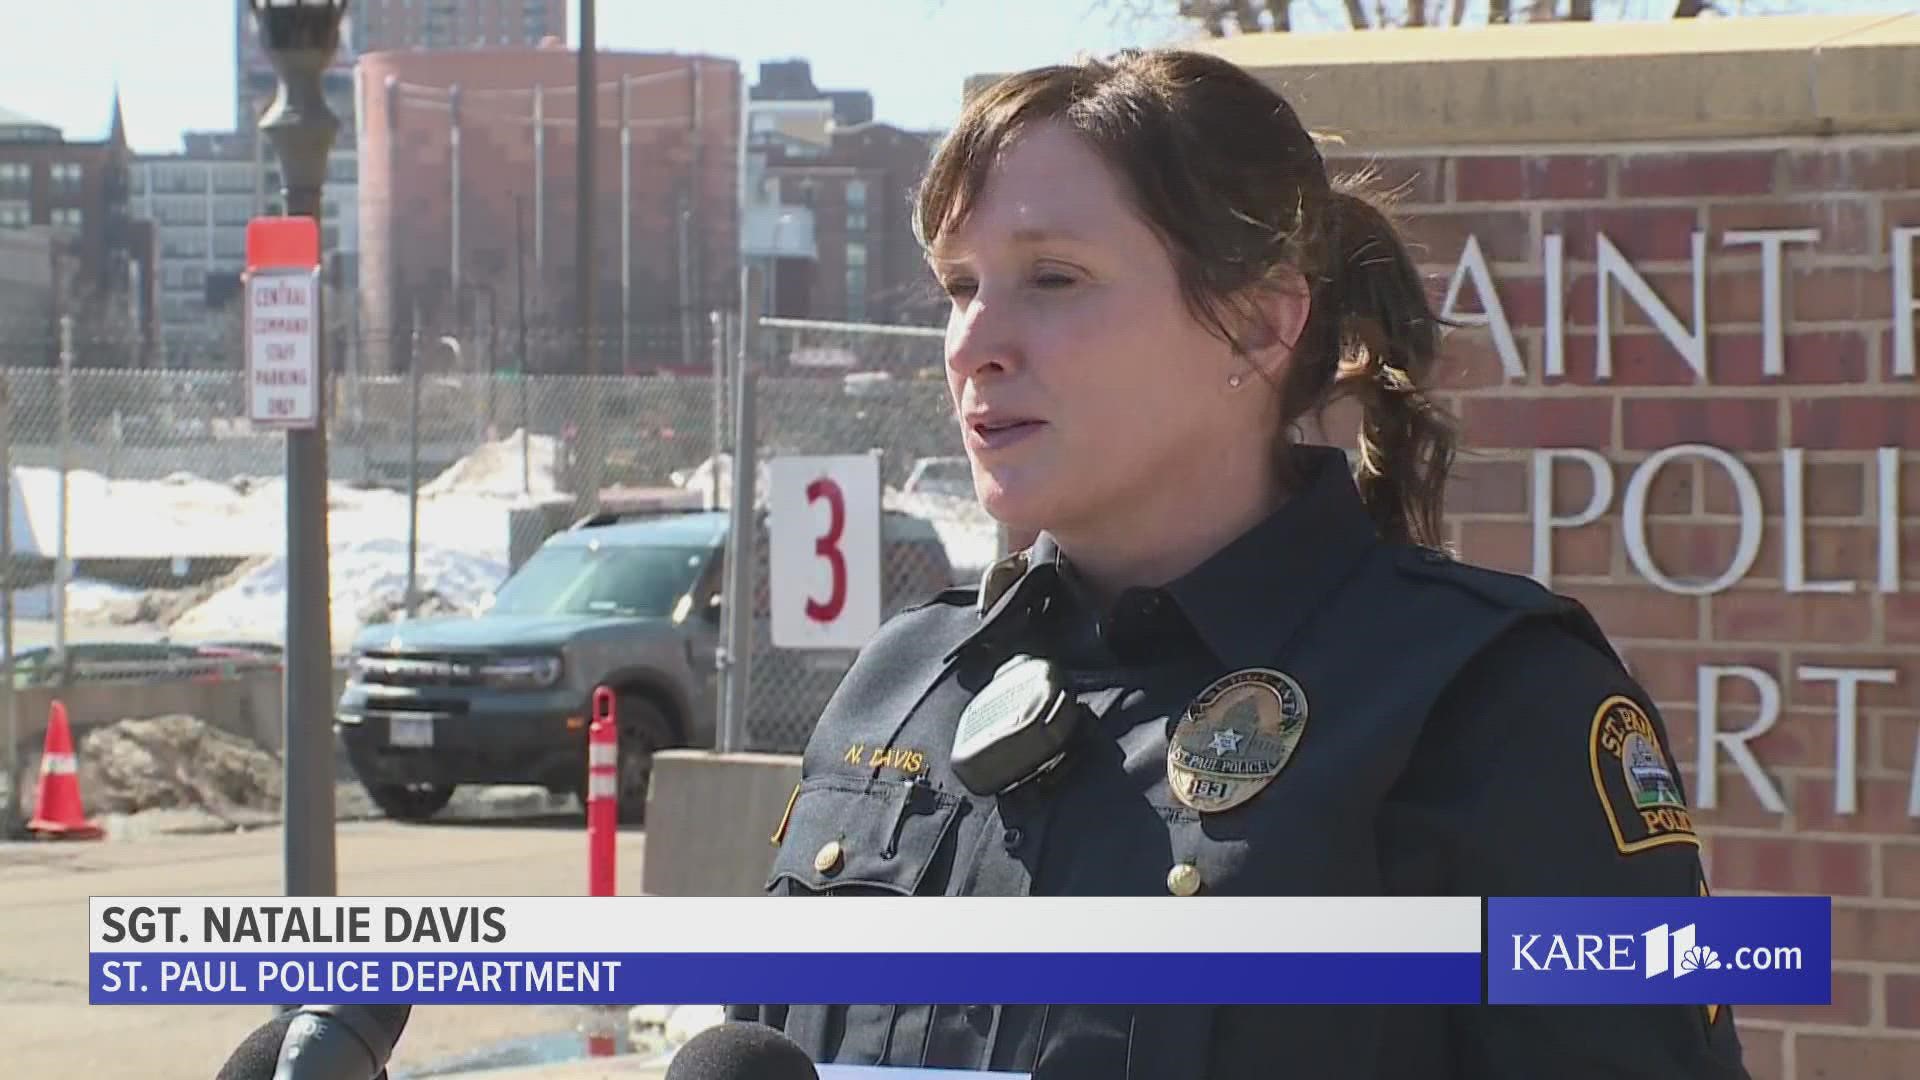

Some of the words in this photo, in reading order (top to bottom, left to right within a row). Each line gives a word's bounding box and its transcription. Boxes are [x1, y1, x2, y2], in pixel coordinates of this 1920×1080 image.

[256, 287, 306, 307] CENTRAL
[1439, 229, 1821, 380] AINT
[255, 317, 308, 335] COMMAND
[255, 368, 307, 386] PARKING
[1531, 443, 1899, 595] POLI
[808, 481, 847, 623] 3
[1697, 664, 1920, 816] RT
[844, 744, 862, 765] N.
[869, 748, 923, 774] DAVIS
[1221, 758, 1271, 774] POLICE
